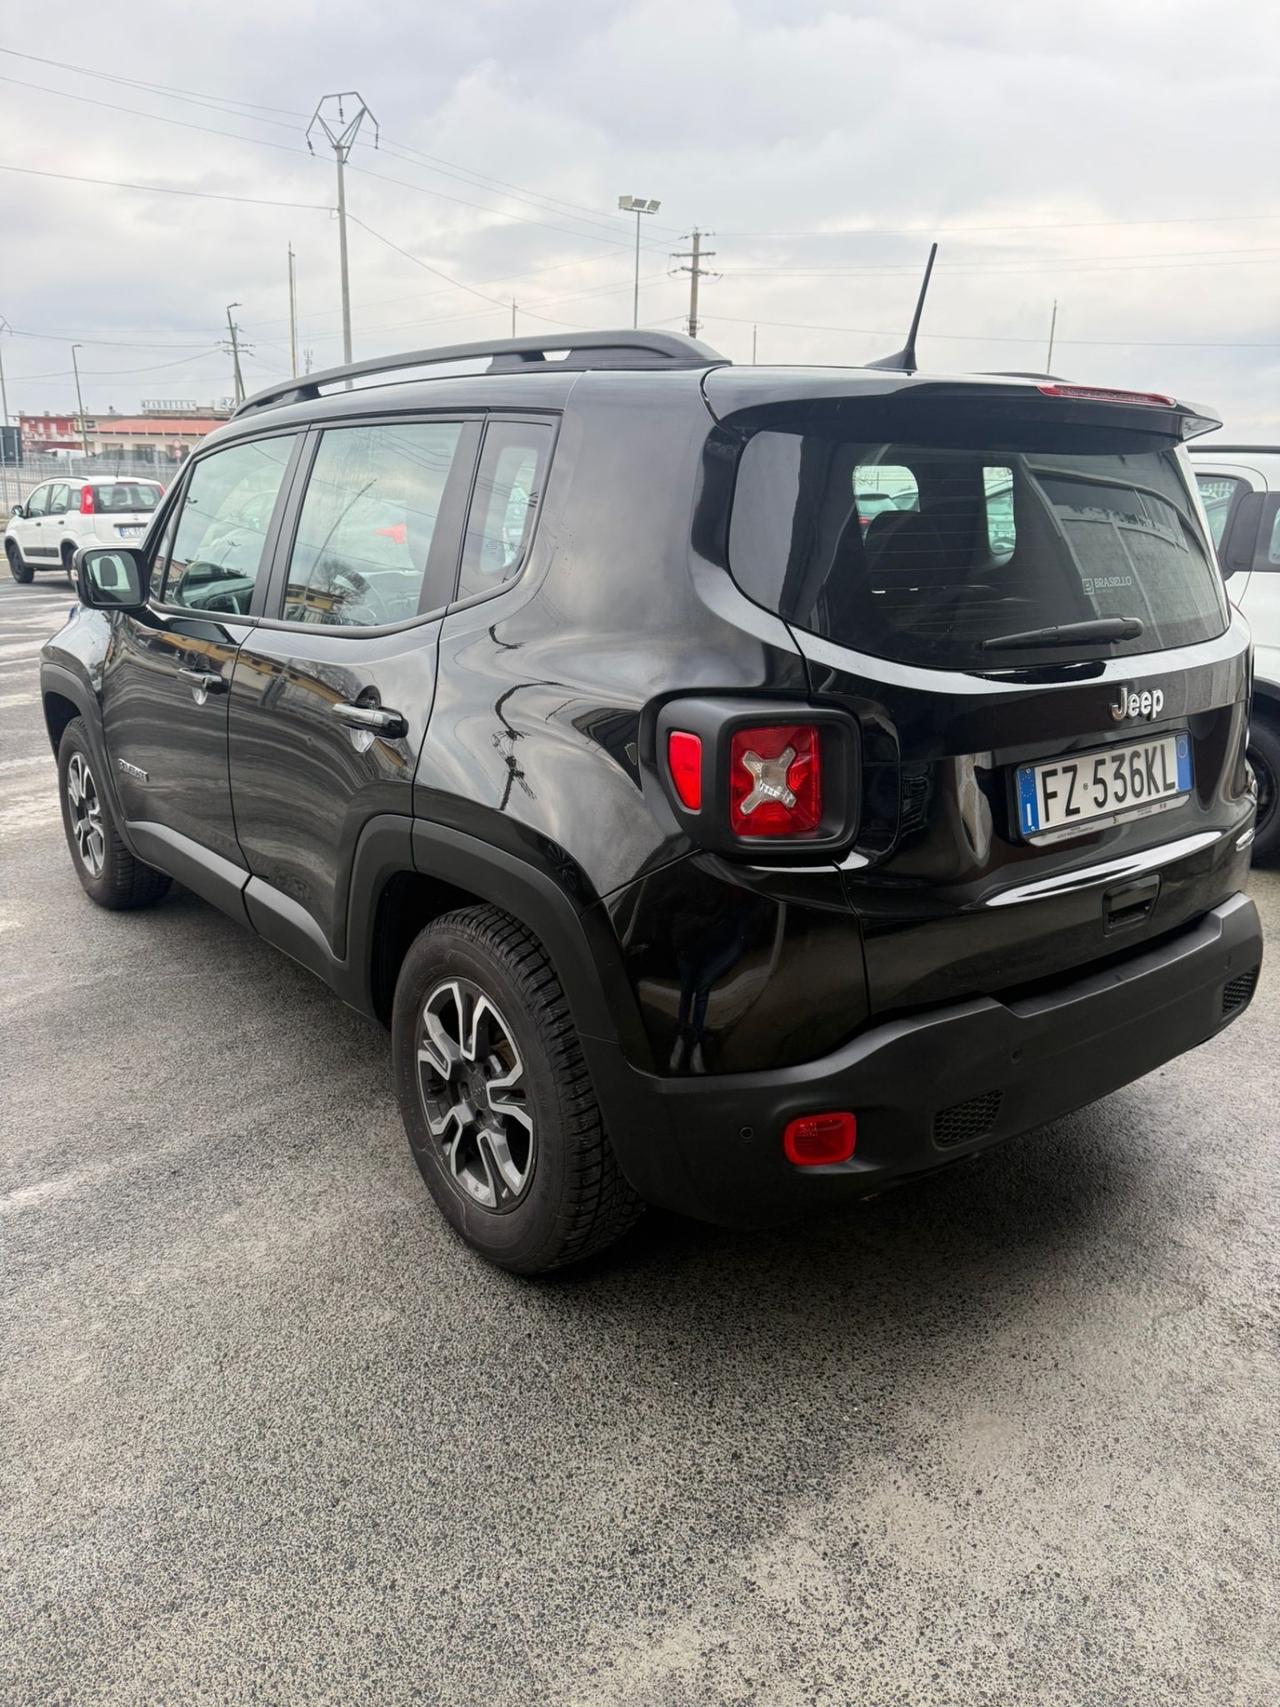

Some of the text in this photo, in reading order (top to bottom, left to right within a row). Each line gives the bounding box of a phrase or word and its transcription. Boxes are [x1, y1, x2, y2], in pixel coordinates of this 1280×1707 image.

[1112, 687, 1164, 720] Jeep
[1041, 744, 1176, 822] FZ 536KL
